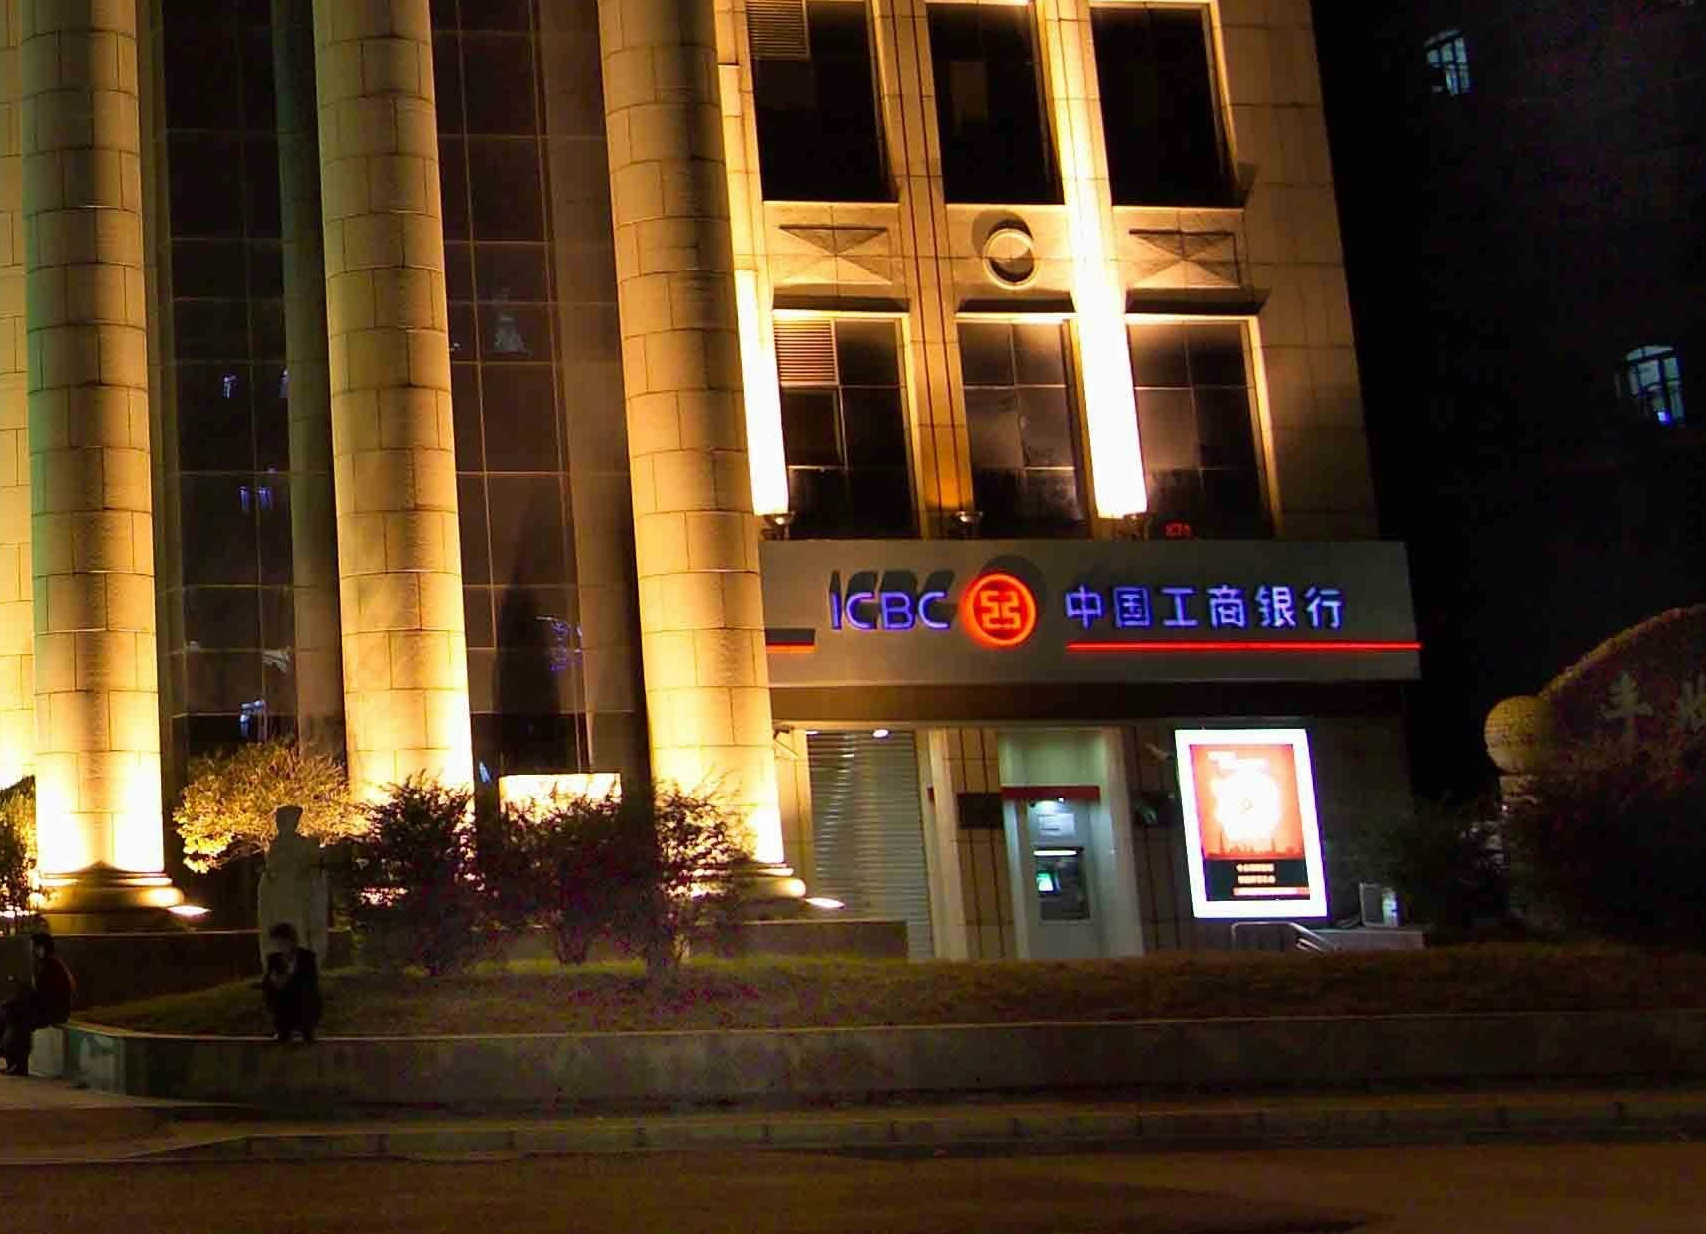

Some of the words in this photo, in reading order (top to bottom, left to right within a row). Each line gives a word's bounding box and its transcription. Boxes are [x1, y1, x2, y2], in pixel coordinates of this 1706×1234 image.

[829, 590, 951, 631] ICBC
[1065, 583, 1343, 630] 中国工商银行
